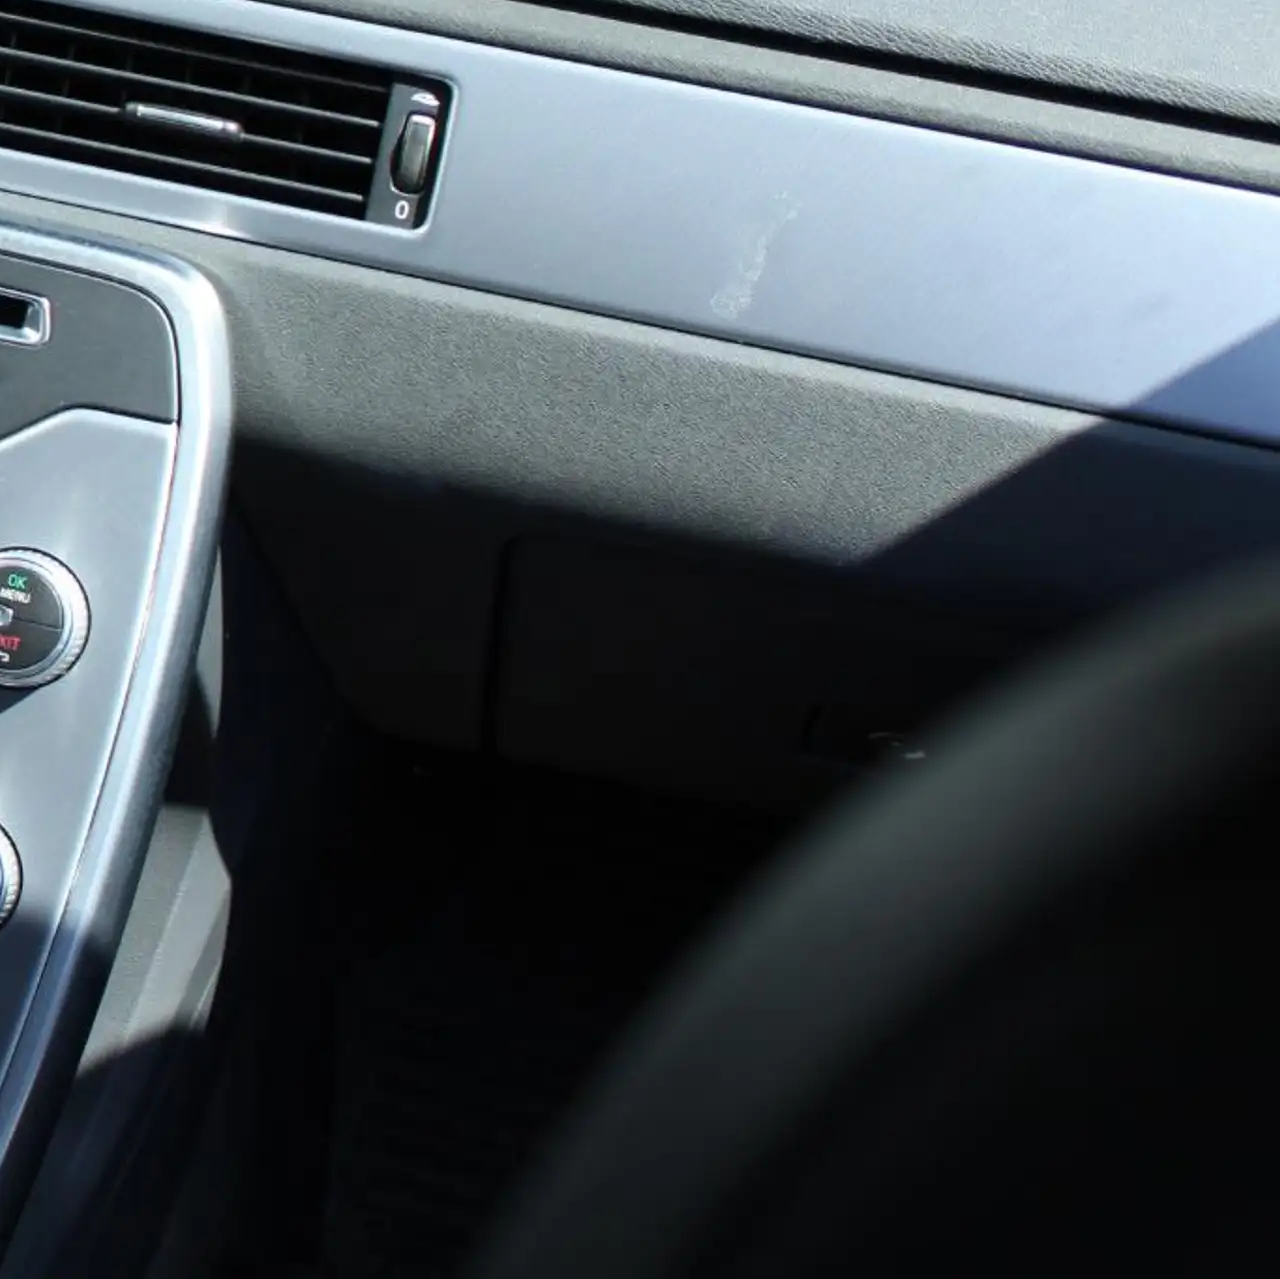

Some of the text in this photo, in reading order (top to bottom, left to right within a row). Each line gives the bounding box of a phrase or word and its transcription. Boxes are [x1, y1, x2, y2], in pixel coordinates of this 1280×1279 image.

[393, 199, 409, 221] 0
[7, 573, 28, 589] OK
[0, 588, 32, 604] MENU
